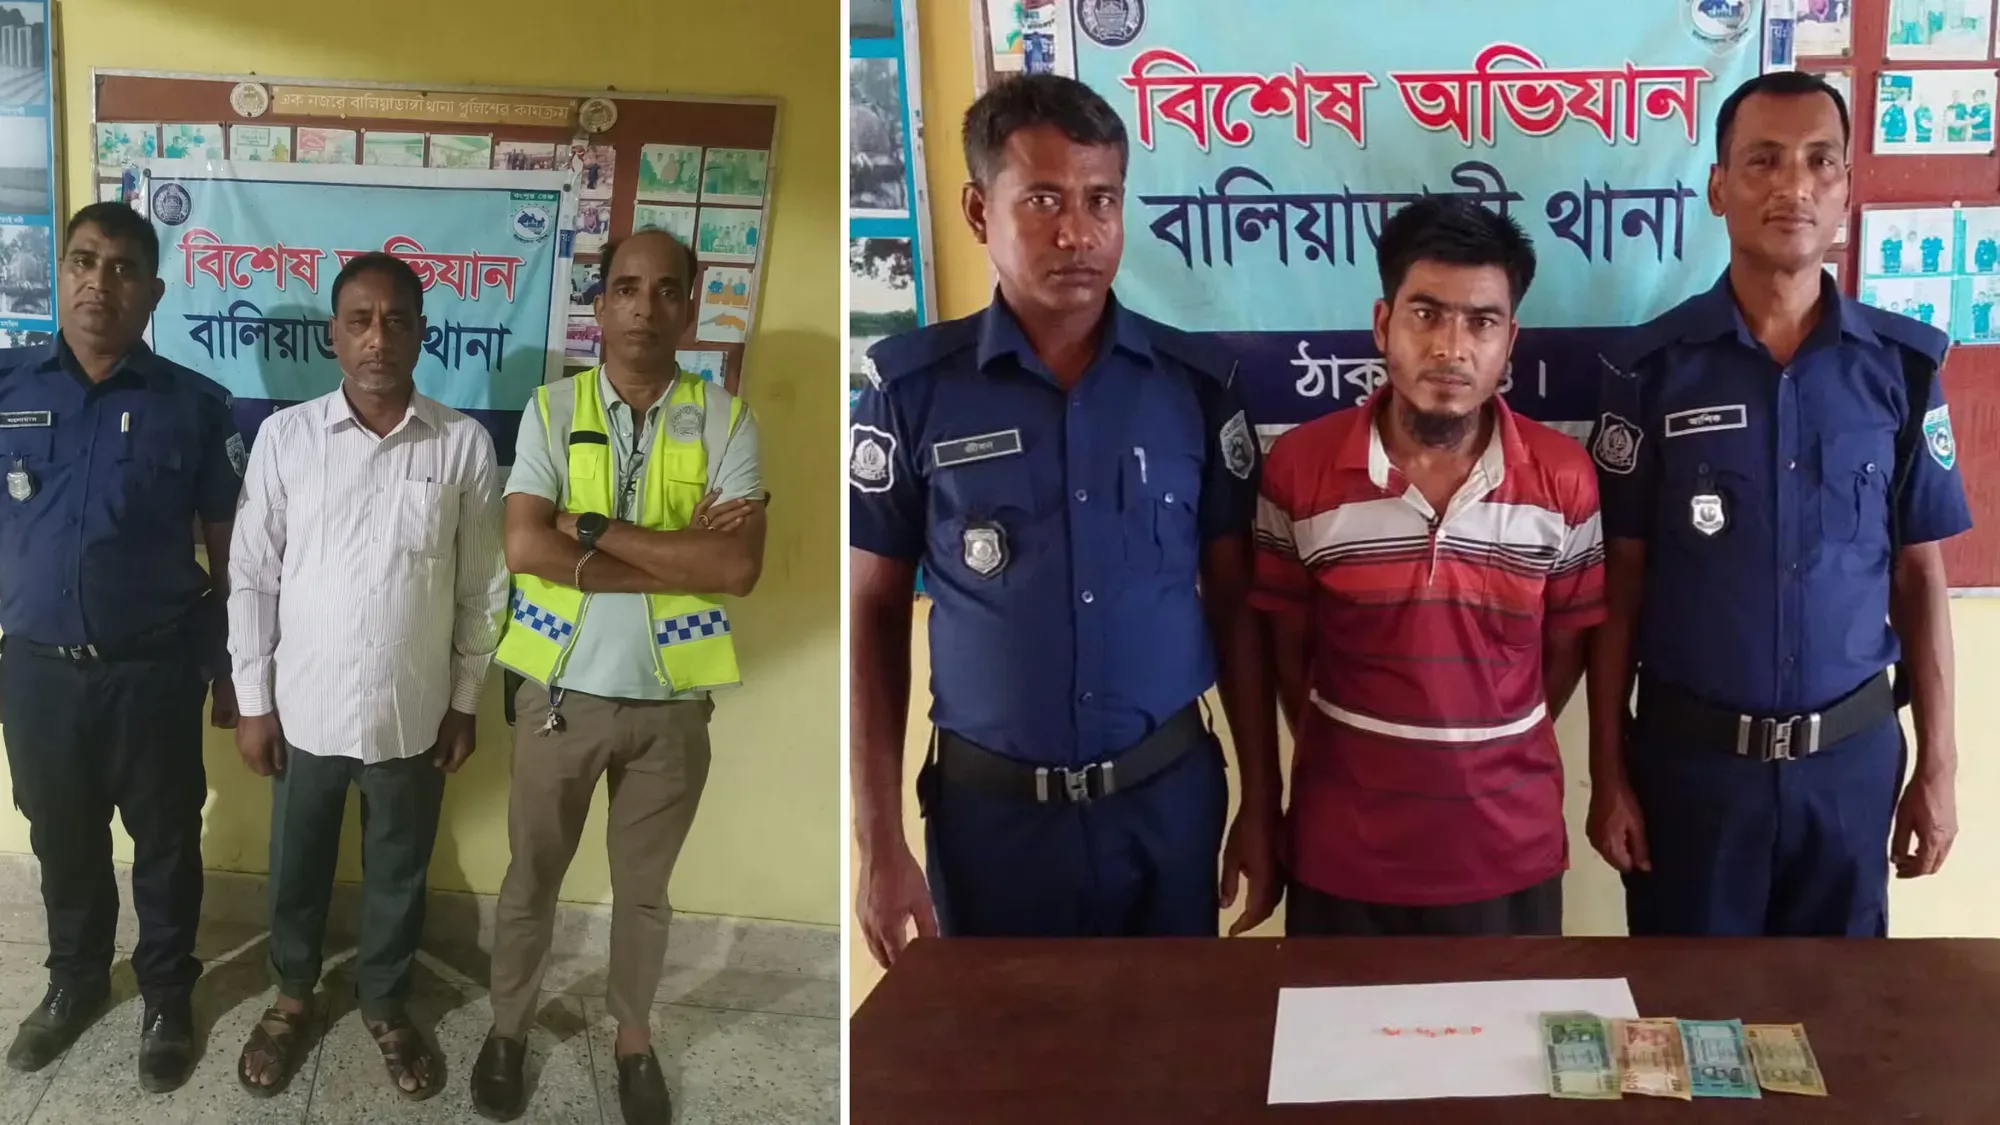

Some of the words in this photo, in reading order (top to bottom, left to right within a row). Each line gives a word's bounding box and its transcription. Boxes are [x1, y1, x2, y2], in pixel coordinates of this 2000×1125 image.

[280, 93, 304, 107] এক
[307, 94, 346, 109] নজরে
[426, 100, 454, 113] থানা
[458, 97, 509, 118] পুলিশের
[1120, 45, 1376, 151] বিশেষ
[1390, 42, 1715, 146] অভিযান
[1545, 180, 1698, 265] থানা
[176, 228, 326, 294] বিশেষ
[333, 235, 526, 303] ভিযান
[422, 318, 512, 373] থানা
